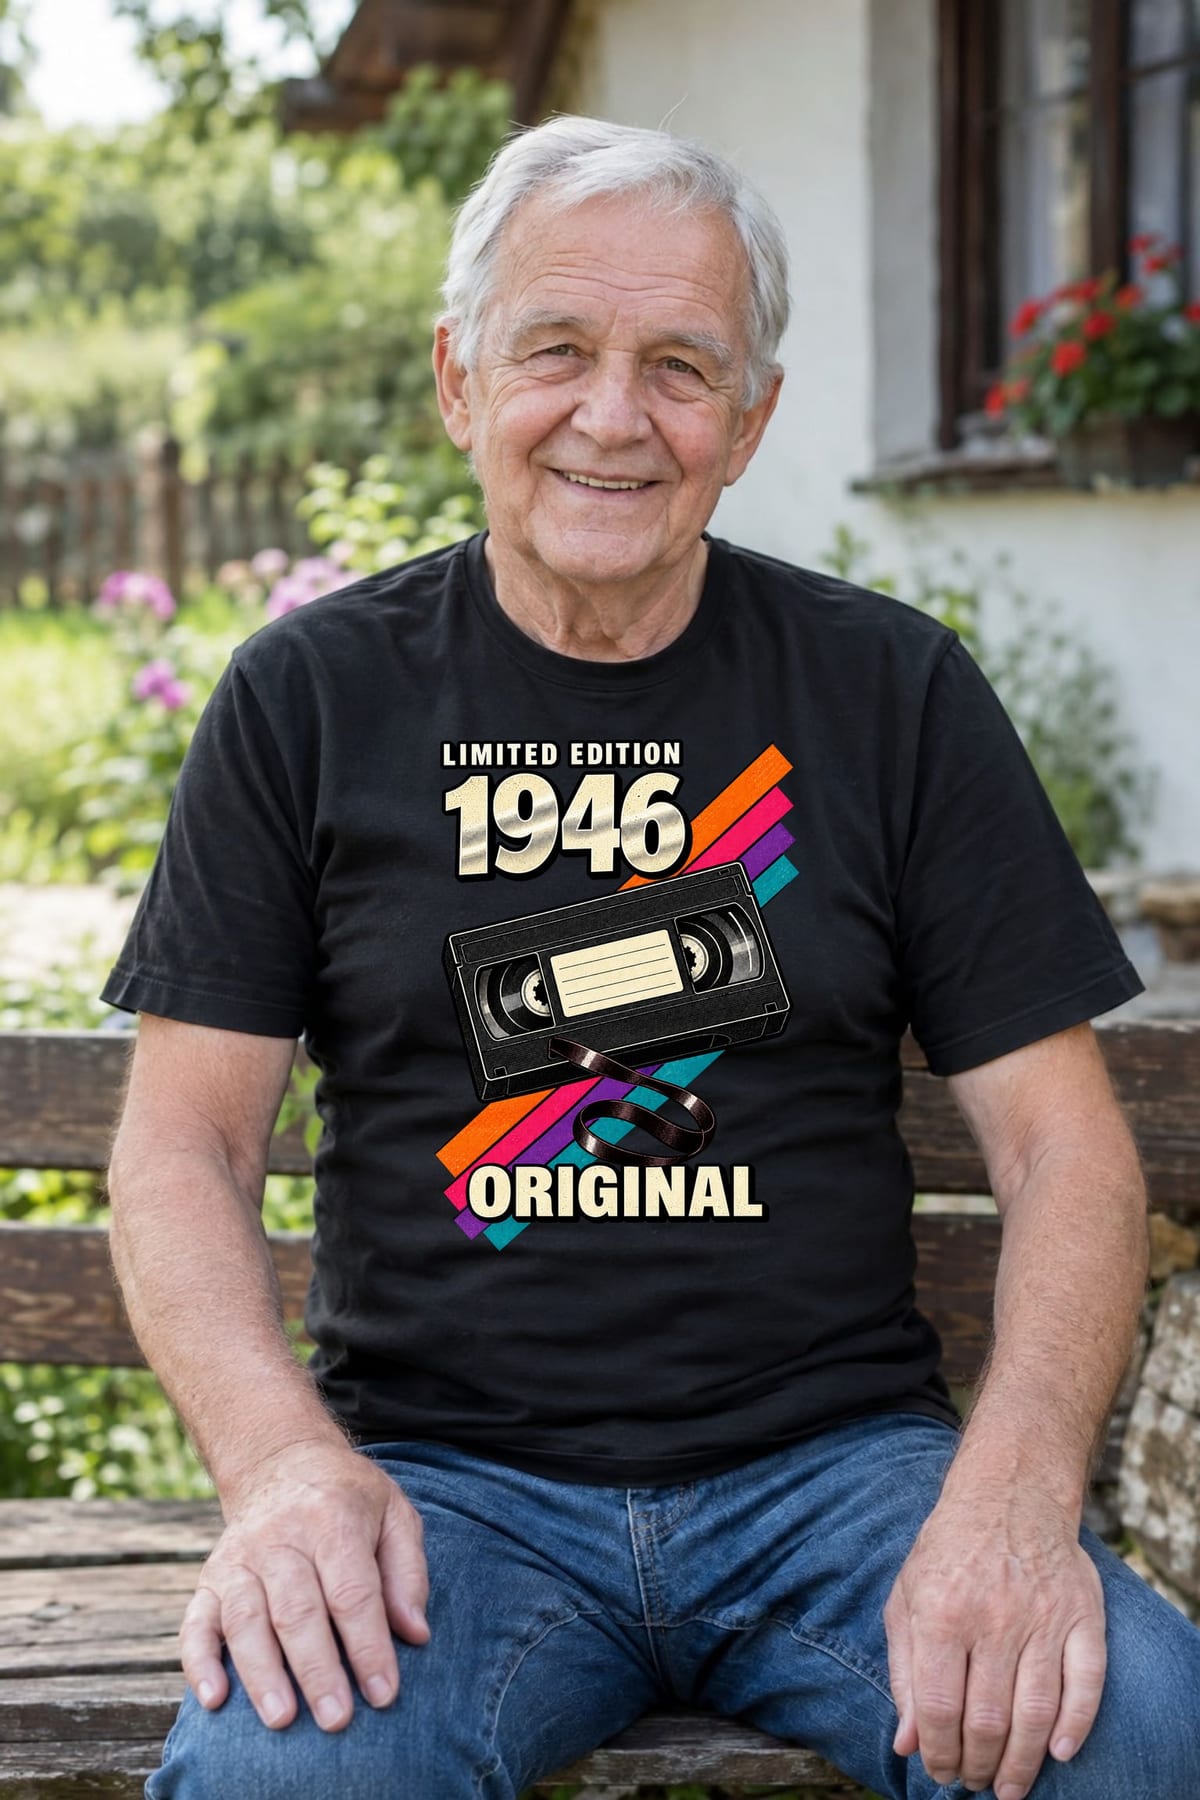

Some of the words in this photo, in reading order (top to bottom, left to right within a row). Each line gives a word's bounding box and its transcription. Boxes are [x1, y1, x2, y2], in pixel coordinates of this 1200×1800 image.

[443, 743, 558, 766] LIMITED
[570, 742, 681, 765] EDITION
[445, 772, 686, 876] 1946
[468, 1165, 763, 1218] ORIGINAL
